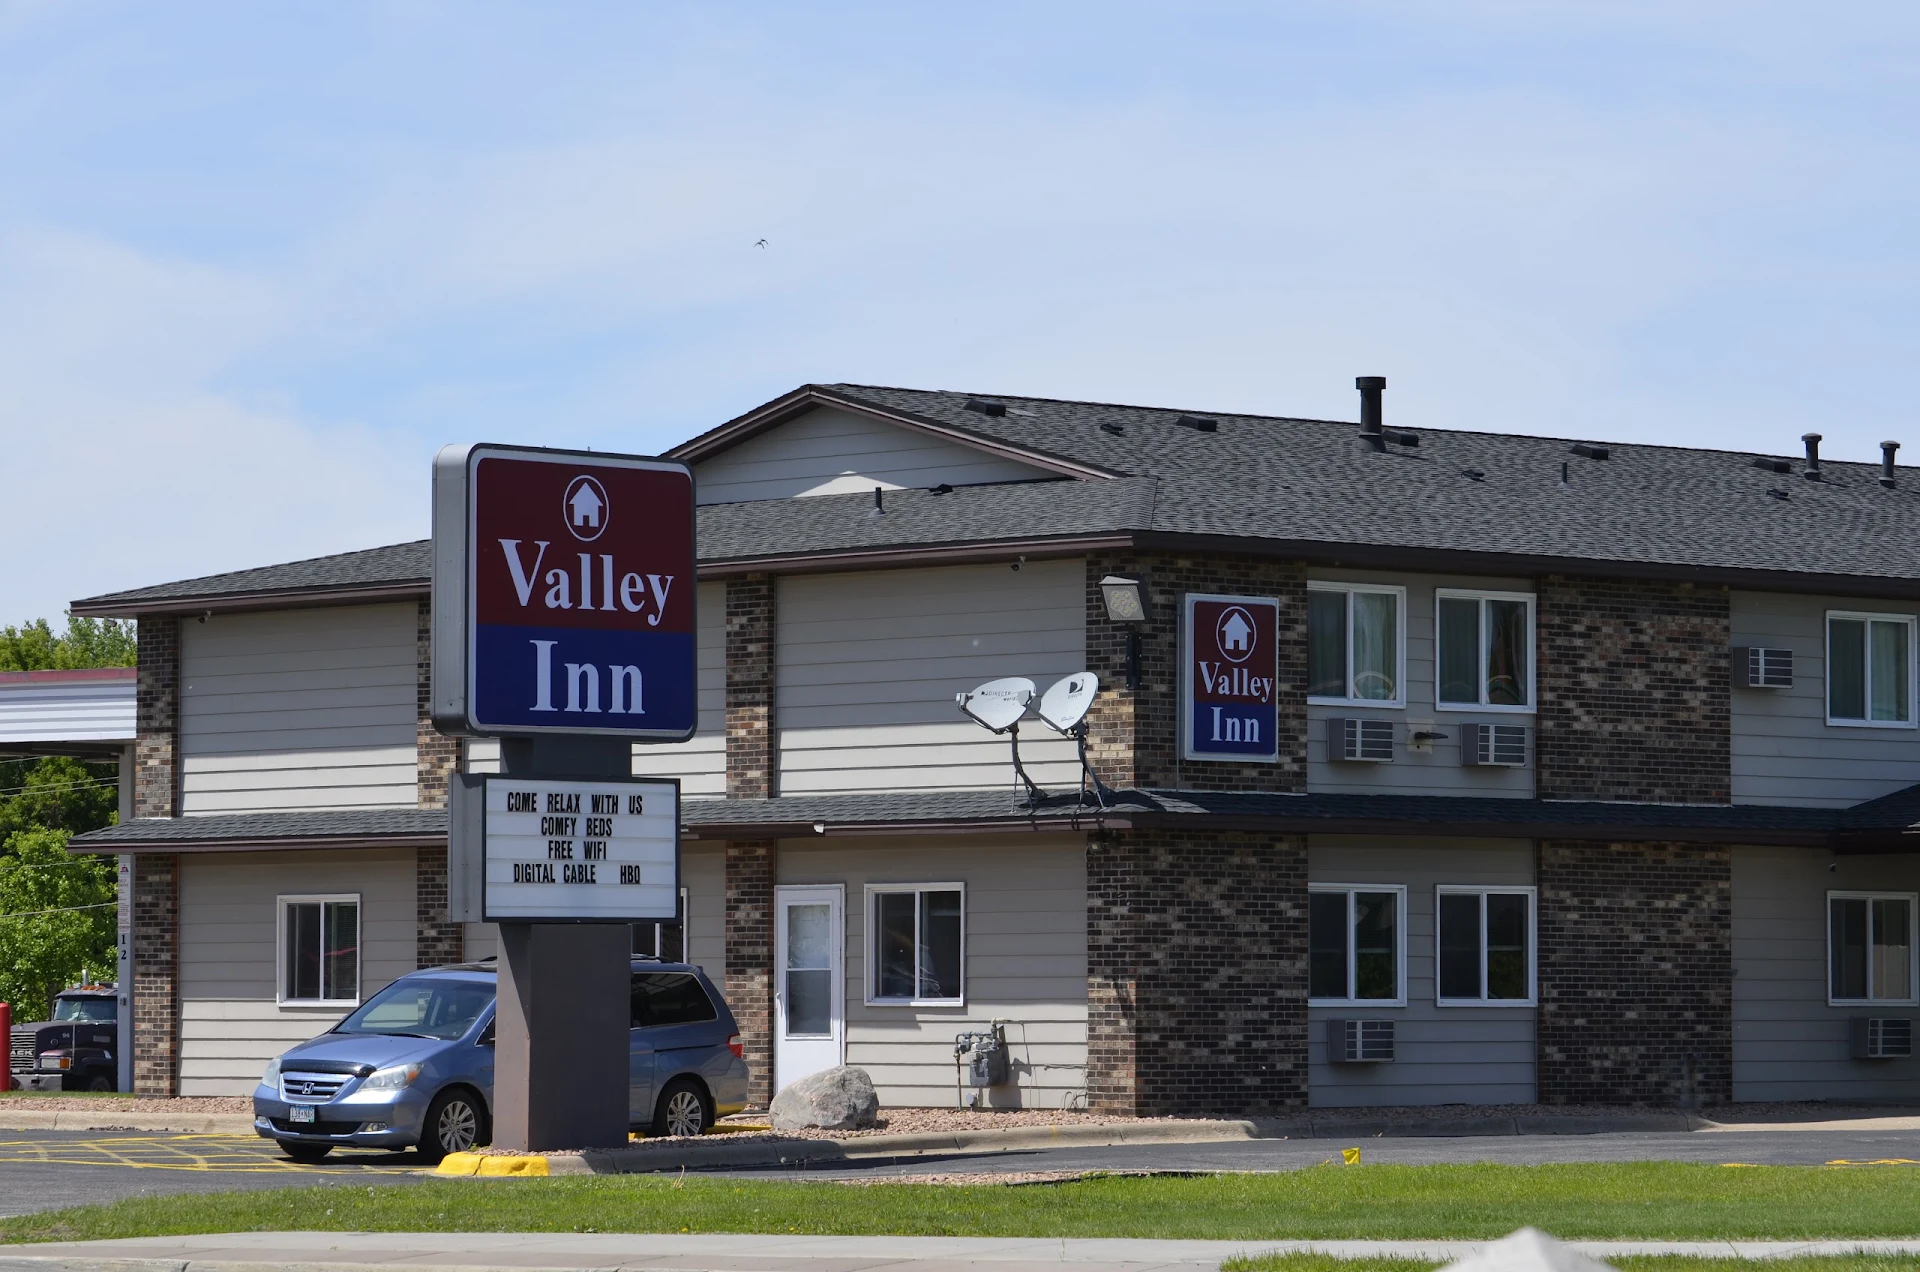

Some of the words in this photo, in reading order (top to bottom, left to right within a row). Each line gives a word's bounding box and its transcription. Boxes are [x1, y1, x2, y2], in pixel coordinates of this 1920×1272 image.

[498, 538, 674, 626] Valley
[529, 640, 645, 714] Inn
[1199, 661, 1273, 703] Valley
[1210, 706, 1260, 743] Inn
[507, 792, 537, 812] COME
[547, 793, 580, 813] RELAX
[591, 794, 618, 814] WITH
[629, 795, 642, 815] US
[541, 817, 577, 836] COMFY
[586, 818, 612, 837] BEDS
[548, 840, 573, 859] FREE
[583, 841, 607, 860] WIFI
[514, 863, 555, 883] DIGITAL
[563, 864, 596, 883] CABLE
[620, 865, 640, 884] HBO
[121, 934, 126, 945] 1
[121, 950, 127, 960] 2
